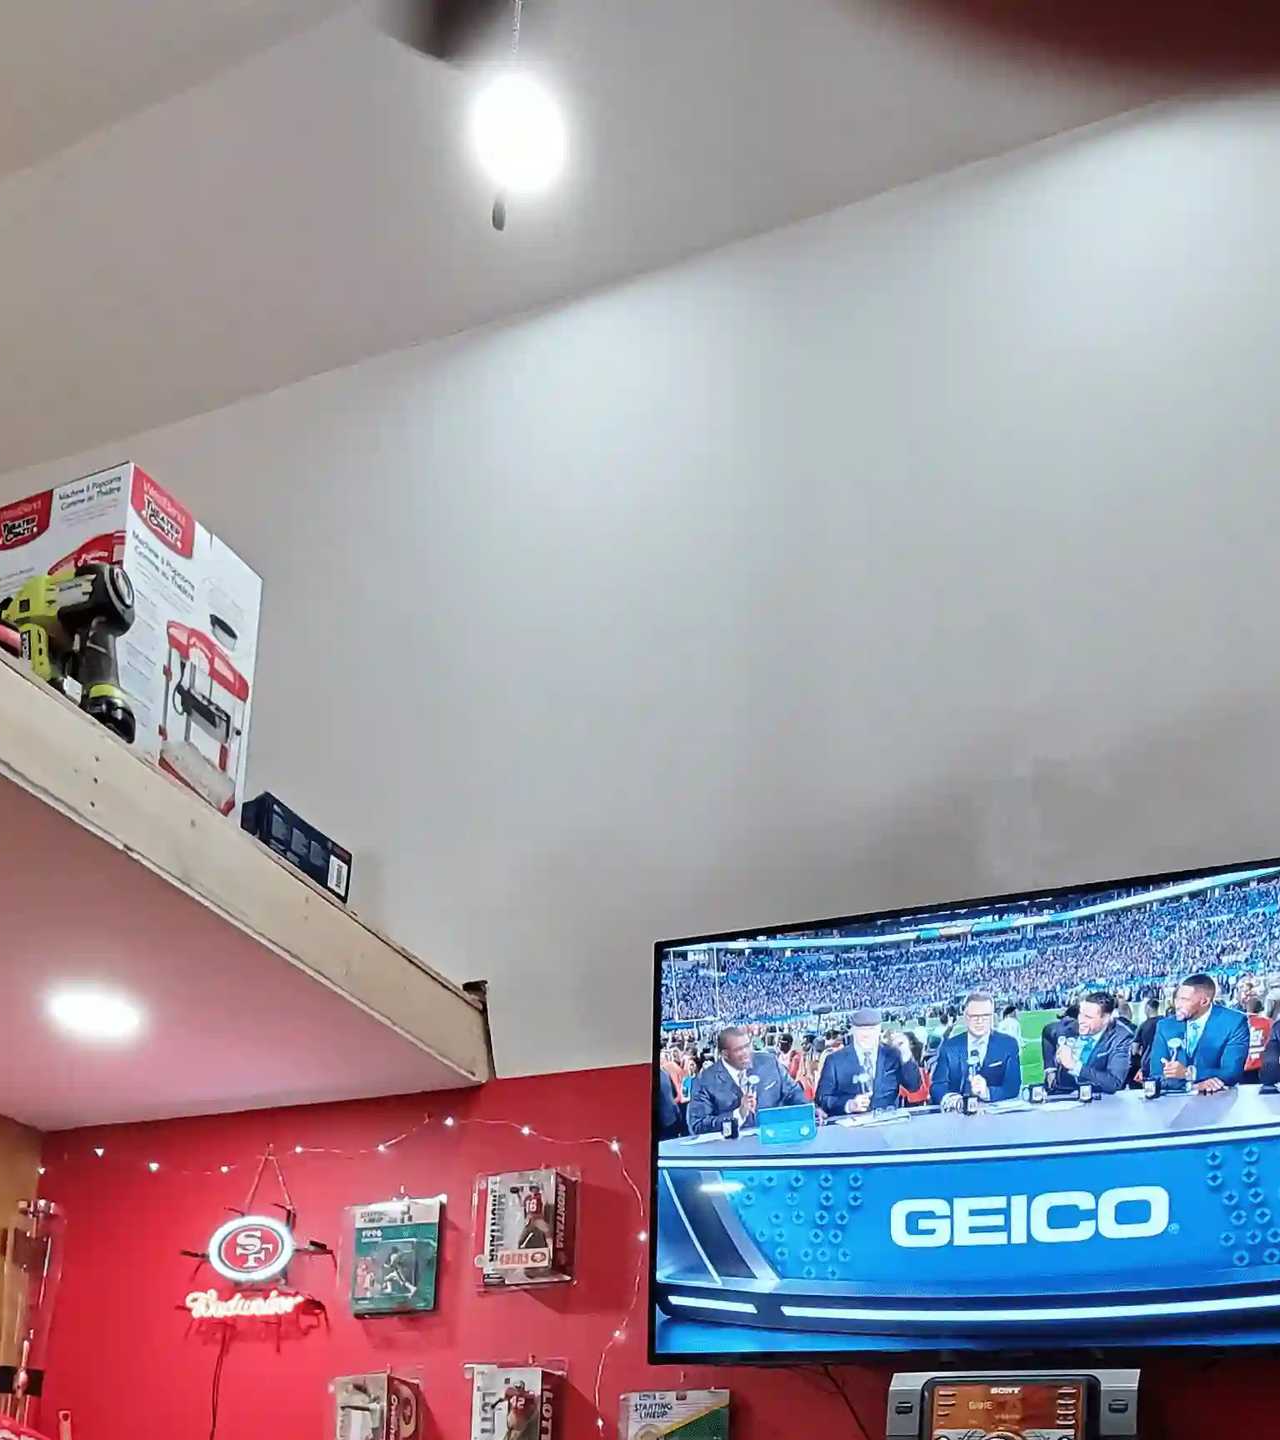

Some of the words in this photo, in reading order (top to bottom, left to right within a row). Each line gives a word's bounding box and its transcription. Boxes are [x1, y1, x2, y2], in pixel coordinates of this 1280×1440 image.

[890, 1186, 1170, 1248] GEICO
[989, 1386, 1022, 1395] SONY
[634, 1402, 673, 1412] STARTING
[640, 1410, 668, 1420] LINEUP
